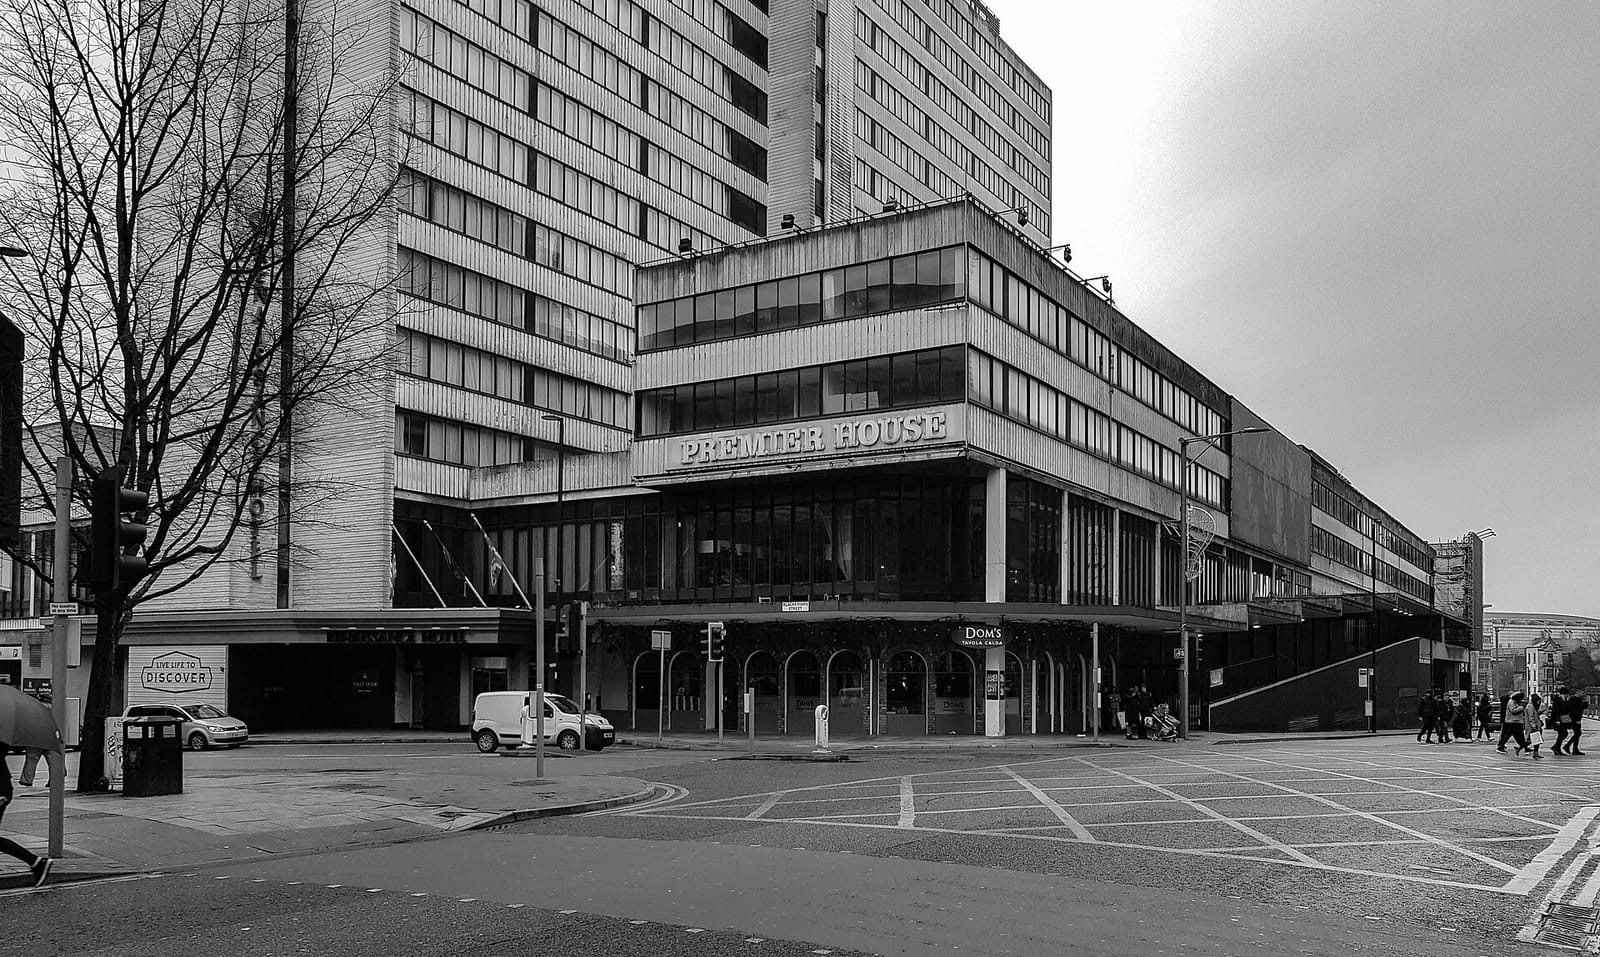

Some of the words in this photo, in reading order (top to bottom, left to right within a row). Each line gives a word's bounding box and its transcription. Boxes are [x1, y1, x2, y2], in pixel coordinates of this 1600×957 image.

[680, 426, 826, 465] PREMIER
[833, 412, 947, 449] HOUSE
[156, 661, 169, 669] LIVE
[171, 661, 185, 669] LIFE
[186, 661, 196, 669] TO
[146, 672, 206, 684] DISCOVER
